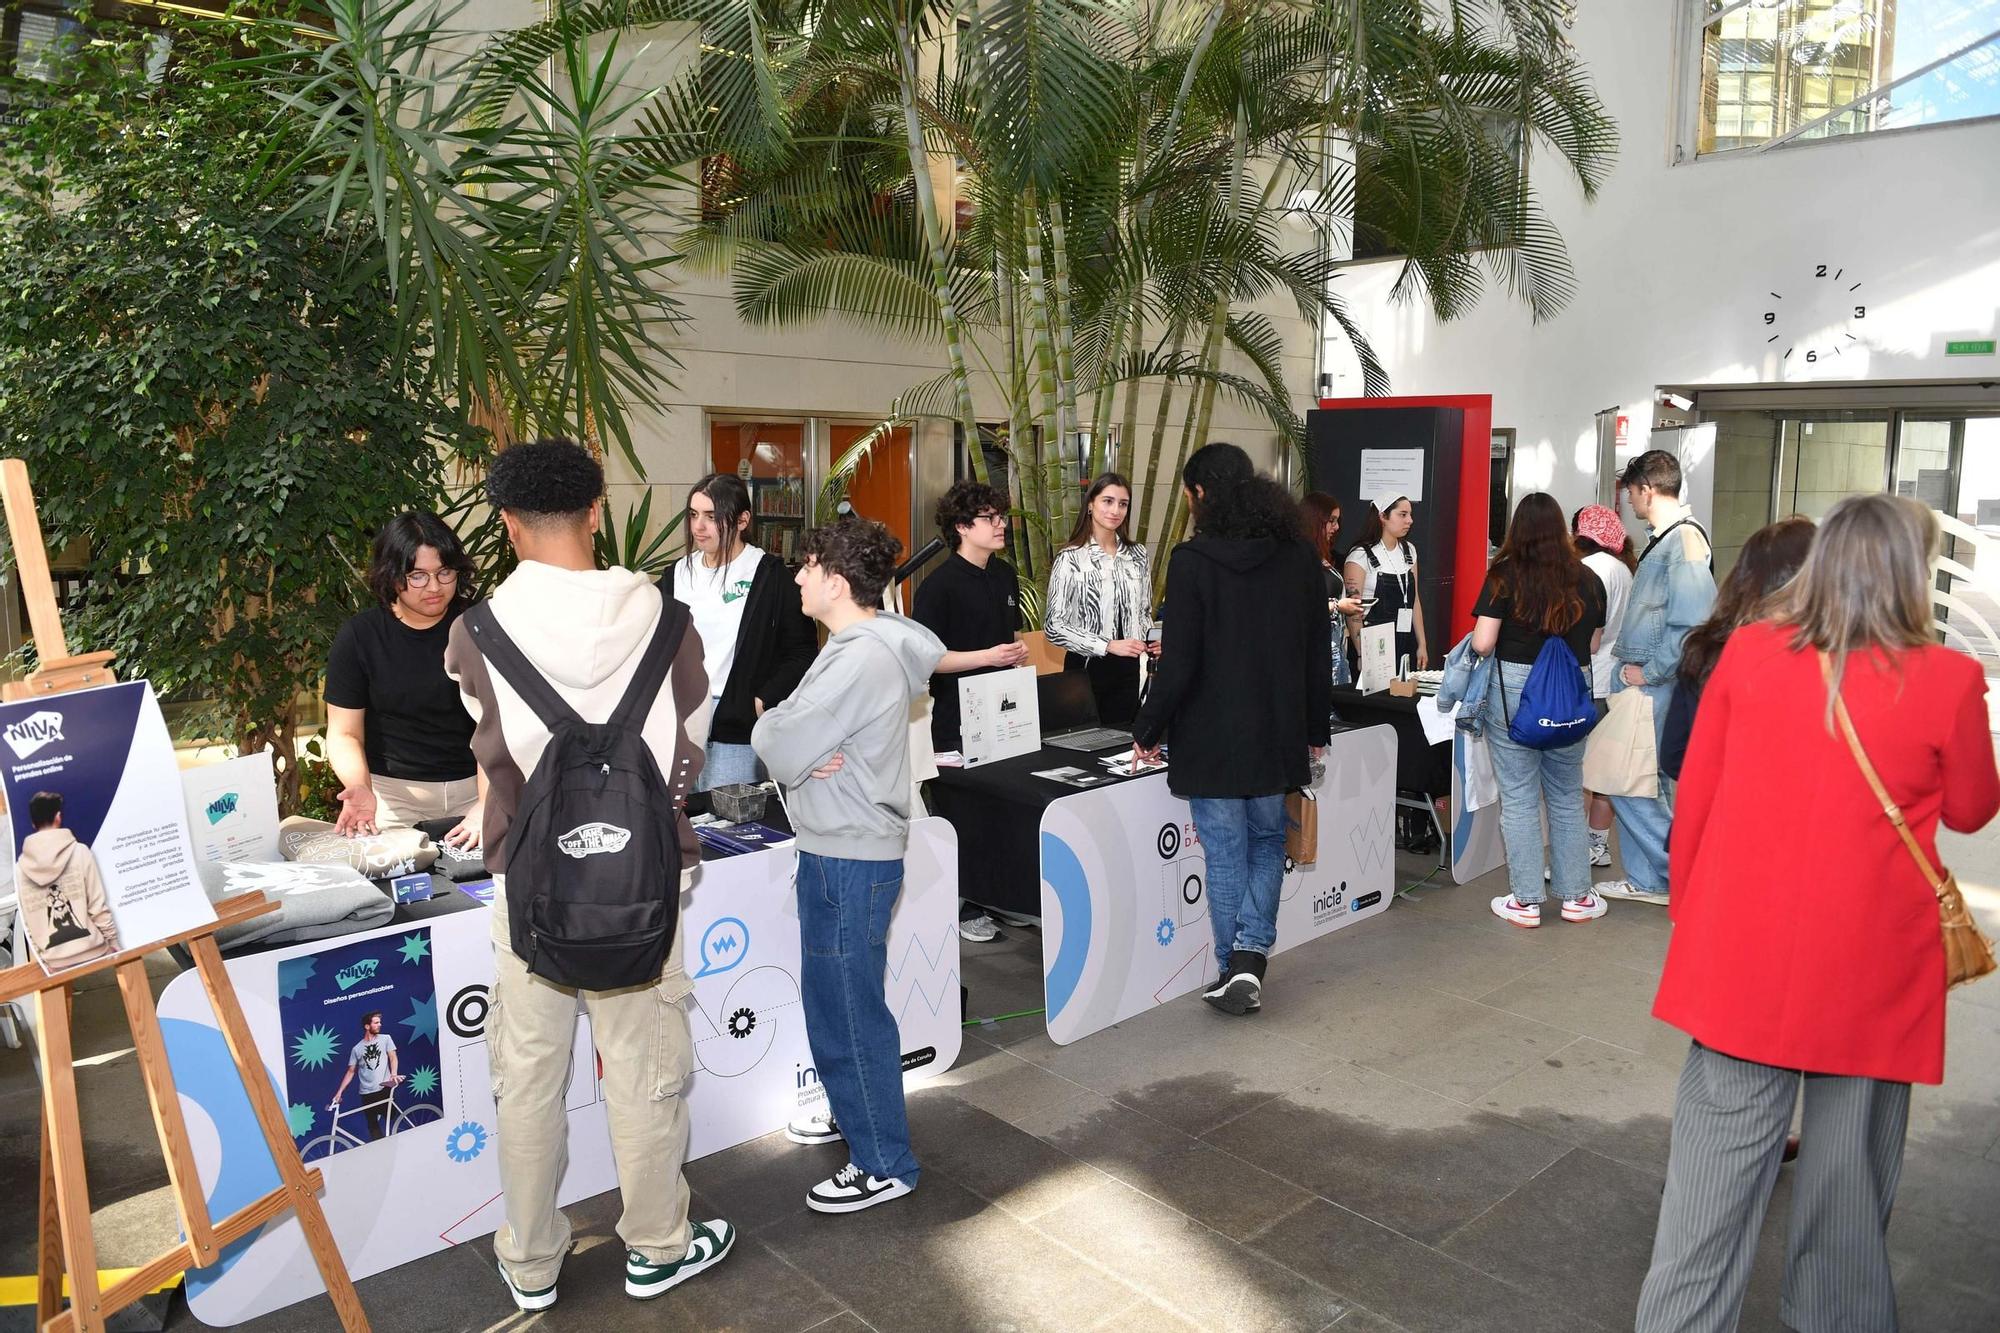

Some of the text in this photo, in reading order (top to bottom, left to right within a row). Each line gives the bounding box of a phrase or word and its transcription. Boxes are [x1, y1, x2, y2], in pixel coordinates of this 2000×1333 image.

[1815, 265, 1826, 277] 2
[1764, 306, 1866, 325] 9 3
[1806, 350, 1817, 362] 6
[7, 719, 64, 741] NILVA
[64, 754, 73, 762] de
[14, 765, 64, 783] prendas online
[208, 797, 237, 814] NILVA
[1184, 822, 1197, 834] FE
[1185, 835, 1200, 848] DA
[1313, 886, 1342, 913] inicia
[340, 964, 376, 979] NILVA
[323, 984, 394, 1006] Diseños personalizables
[797, 1094, 821, 1107] Cultura
